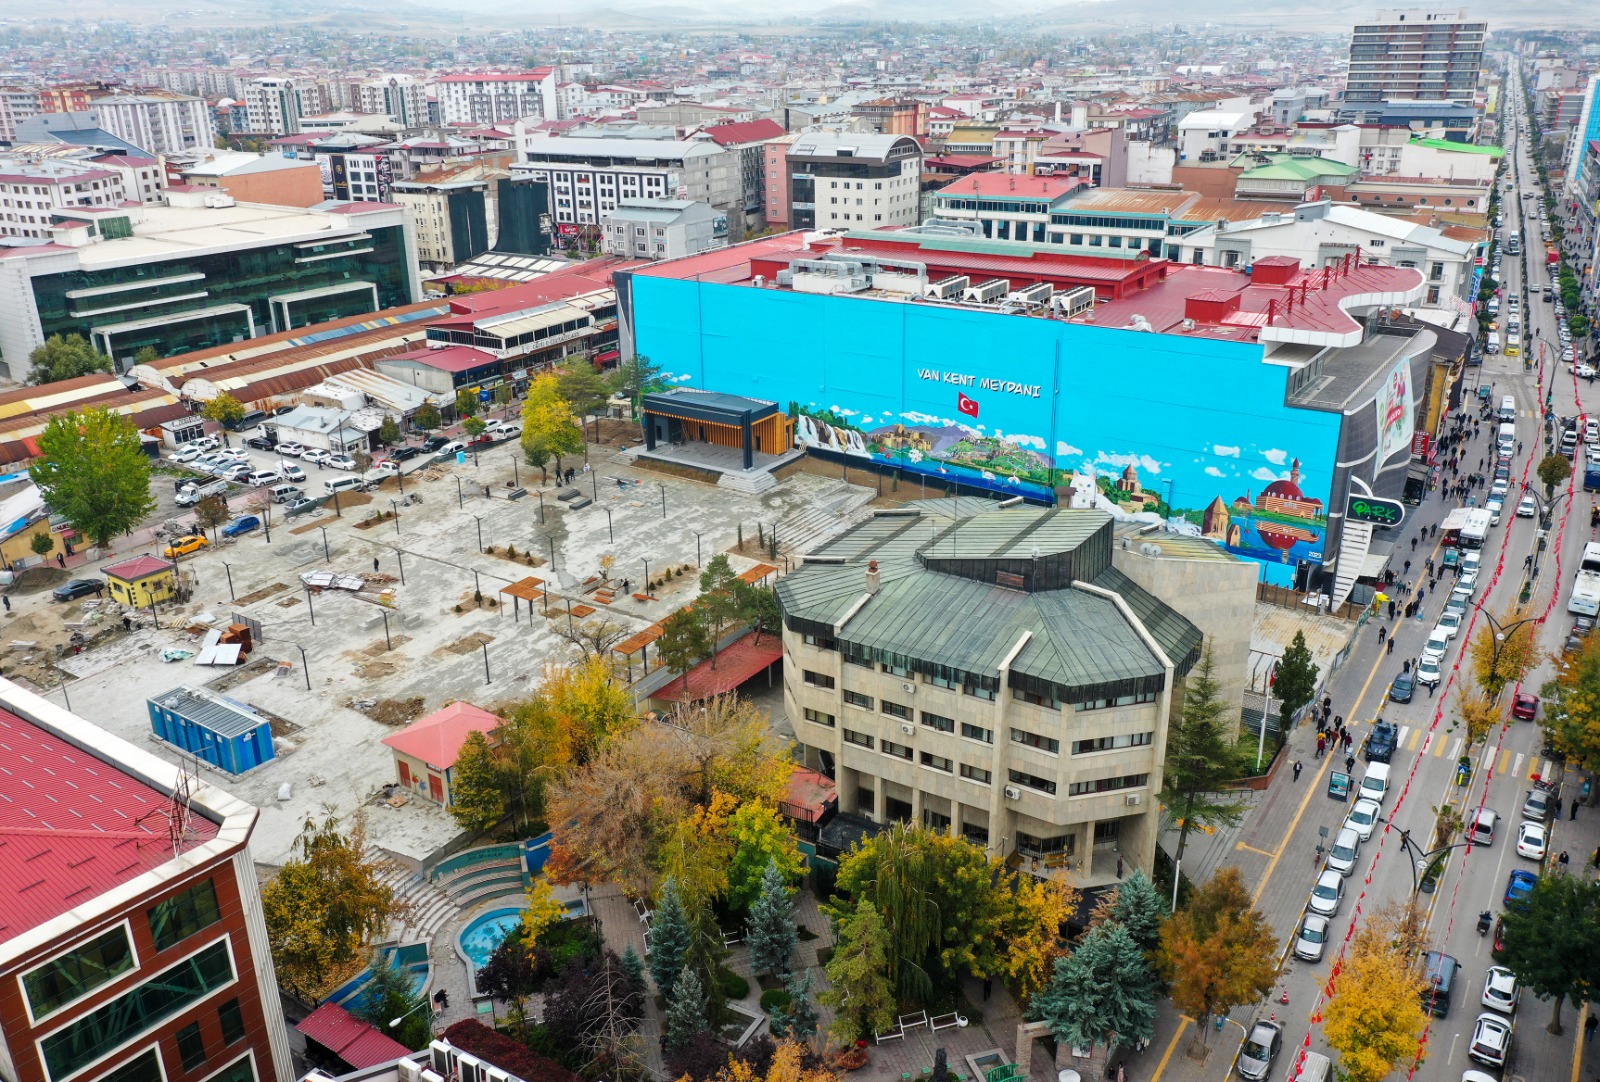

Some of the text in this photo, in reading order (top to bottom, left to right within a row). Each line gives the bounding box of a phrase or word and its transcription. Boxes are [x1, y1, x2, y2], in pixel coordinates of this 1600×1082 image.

[917, 368, 1041, 398] VAN KENT MEYDANI
[1352, 500, 1396, 520] PARK
[1308, 550, 1322, 558] 2023
